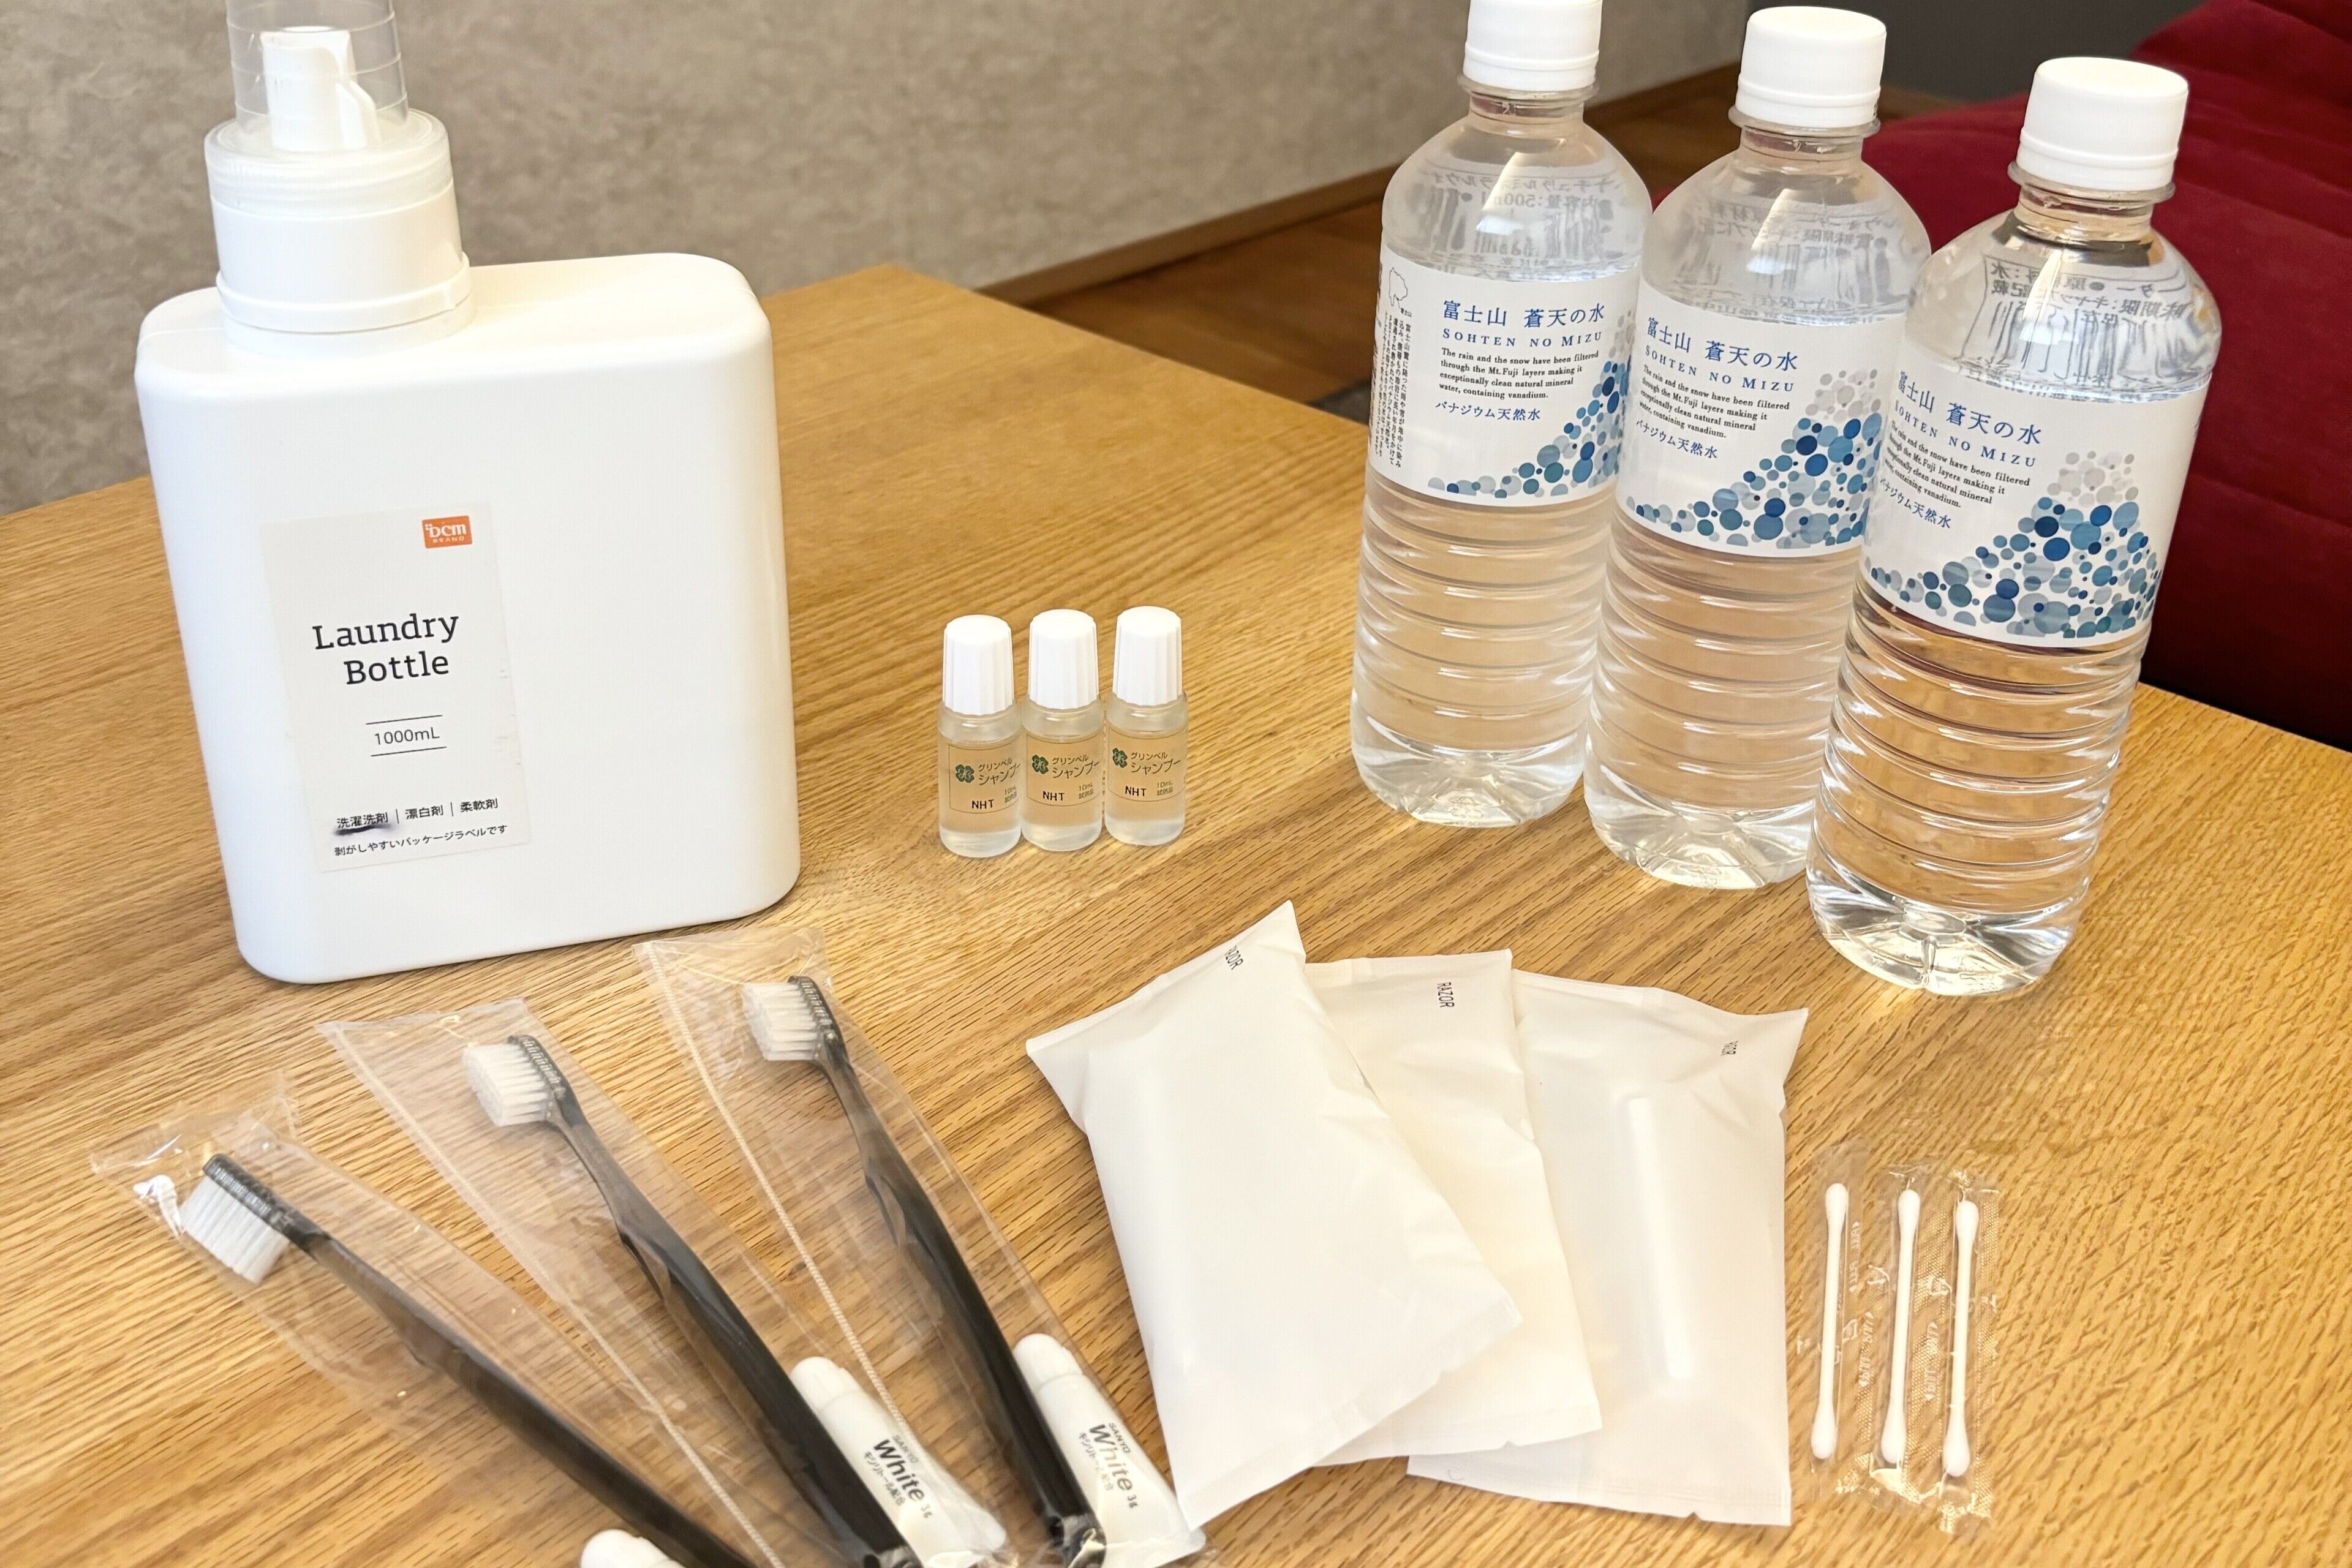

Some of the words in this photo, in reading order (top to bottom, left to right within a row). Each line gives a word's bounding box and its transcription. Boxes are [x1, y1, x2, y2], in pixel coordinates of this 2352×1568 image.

[1444, 300, 1507, 326] 富士山
[1524, 303, 1604, 328] 蒼天の水
[1442, 328, 1515, 347] SOHTEN
[1530, 338, 1551, 347] NO
[1561, 331, 1601, 347] MIZU
[1647, 317, 1691, 353] 富士山
[1705, 341, 1798, 371] 蒼天の水
[1442, 347, 1455, 357] The
[1574, 350, 1599, 361] filtered
[1645, 345, 1697, 376] SOHTEN
[1709, 372, 1731, 384] NO
[1742, 377, 1793, 391] MIZU
[1439, 372, 1489, 387] exceptionally
[1545, 377, 1574, 386] mineral
[1441, 360, 1470, 372] through
[1522, 369, 1545, 378] layers
[1439, 383, 1461, 394] water,
[1463, 389, 1505, 400] containing
[1653, 373, 1663, 382] rain
[1665, 379, 1676, 388] and
[1678, 383, 1689, 392] the
[1691, 389, 1709, 398] snow
[1711, 392, 1730, 402] have
[1733, 396, 1753, 407] been
[1757, 399, 1790, 410] filtered
[1661, 388, 1670, 398] the
[1701, 401, 1724, 413] layers
[1727, 409, 1758, 421] making
[1674, 407, 1692, 418] clean
[1694, 413, 1721, 425] natural
[1724, 420, 1756, 431] mineral
[1898, 371, 1935, 413] 富士山
[1946, 402, 2041, 445] 蒼天の水
[1653, 410, 1685, 429] containing
[1687, 424, 1726, 438] vanadium.
[1918, 444, 1928, 453] the
[1930, 451, 1947, 462] snow
[1949, 458, 1968, 470] have
[1970, 465, 1991, 478] been
[1995, 472, 2030, 486] filtered
[1948, 435, 1970, 451] NO
[1980, 446, 2035, 467] MIZU
[1913, 469, 1929, 481] clean
[1931, 478, 1958, 493] natural
[1959, 491, 1992, 503] mineral
[1939, 466, 1960, 481] layers
[1963, 478, 1995, 494] making
[1998, 486, 2005, 494] it
[1924, 488, 1961, 507] vanadium.
[312, 612, 459, 650] Laundry
[344, 650, 449, 685] Bottle
[375, 726, 440, 745] 1000mL
[972, 799, 994, 809] NHT
[1043, 791, 1065, 801] NHT
[1125, 786, 1147, 796] NHT
[405, 805, 443, 820] 漂白剤
[461, 797, 498, 813] 柔軟剤
[1437, 982, 1455, 1008] RAZOR
[1109, 1423, 1131, 1453] SANYO
[874, 1439, 925, 1501] White
[1090, 1424, 1133, 1490] White
